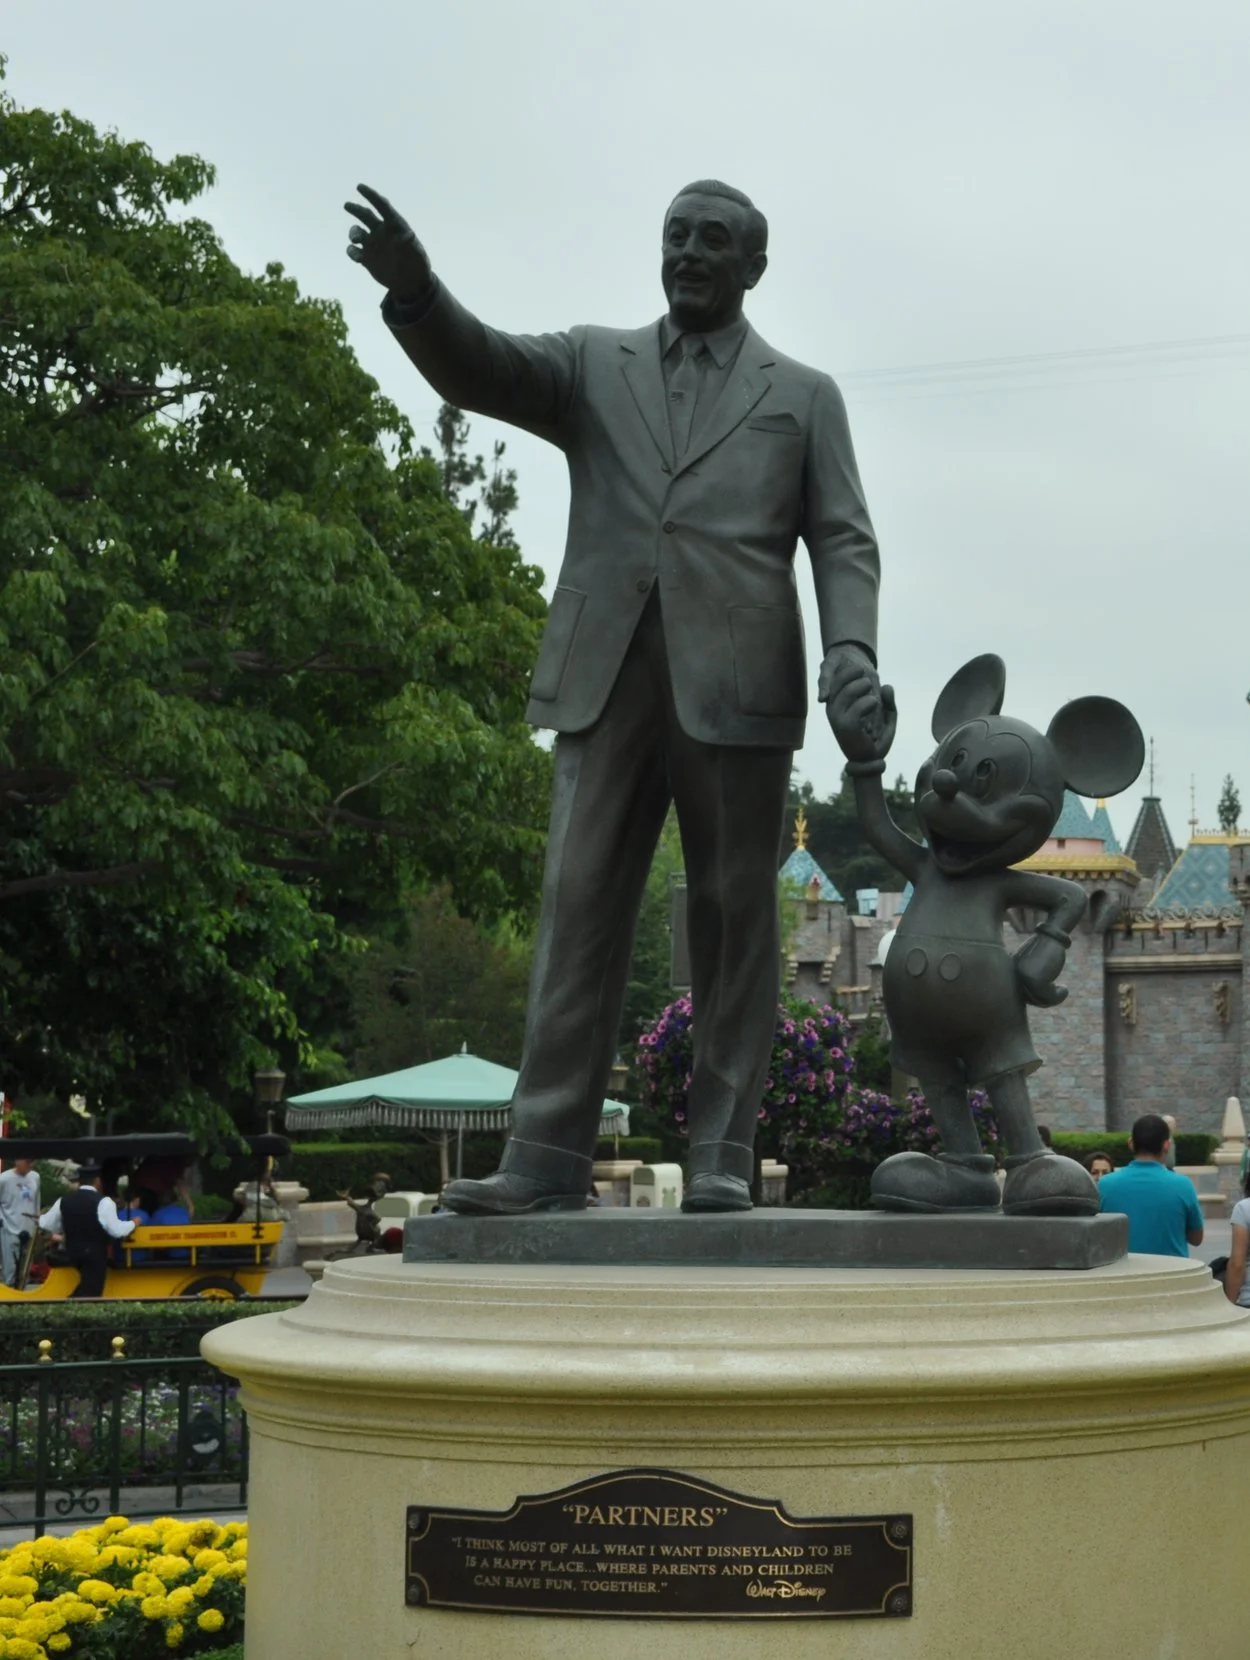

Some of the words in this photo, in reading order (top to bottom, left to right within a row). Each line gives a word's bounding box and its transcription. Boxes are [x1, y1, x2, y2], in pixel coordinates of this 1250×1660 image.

[562, 1504, 728, 1527] “PARTNERS”
[465, 1537, 505, 1551] THINK
[508, 1540, 546, 1553] MOST
[550, 1542, 568, 1554] OF
[572, 1543, 601, 1555] ALL
[604, 1544, 647, 1556] WHAT
[649, 1545, 656, 1557] I
[659, 1545, 703, 1557] WANT
[707, 1545, 804, 1558] DISNEYLAND
[807, 1545, 829, 1557] TO
[833, 1544, 853, 1556] BE
[465, 1555, 477, 1568] IS
[480, 1557, 490, 1569] A
[493, 1557, 537, 1571] HAPPY
[651, 1563, 717, 1576] PARENTS
[721, 1564, 754, 1576] AND
[757, 1563, 835, 1576] CHILDREN
[474, 1574, 501, 1587] CAN
[505, 1576, 541, 1590] HAVE
[545, 1578, 577, 1592] FUN,
